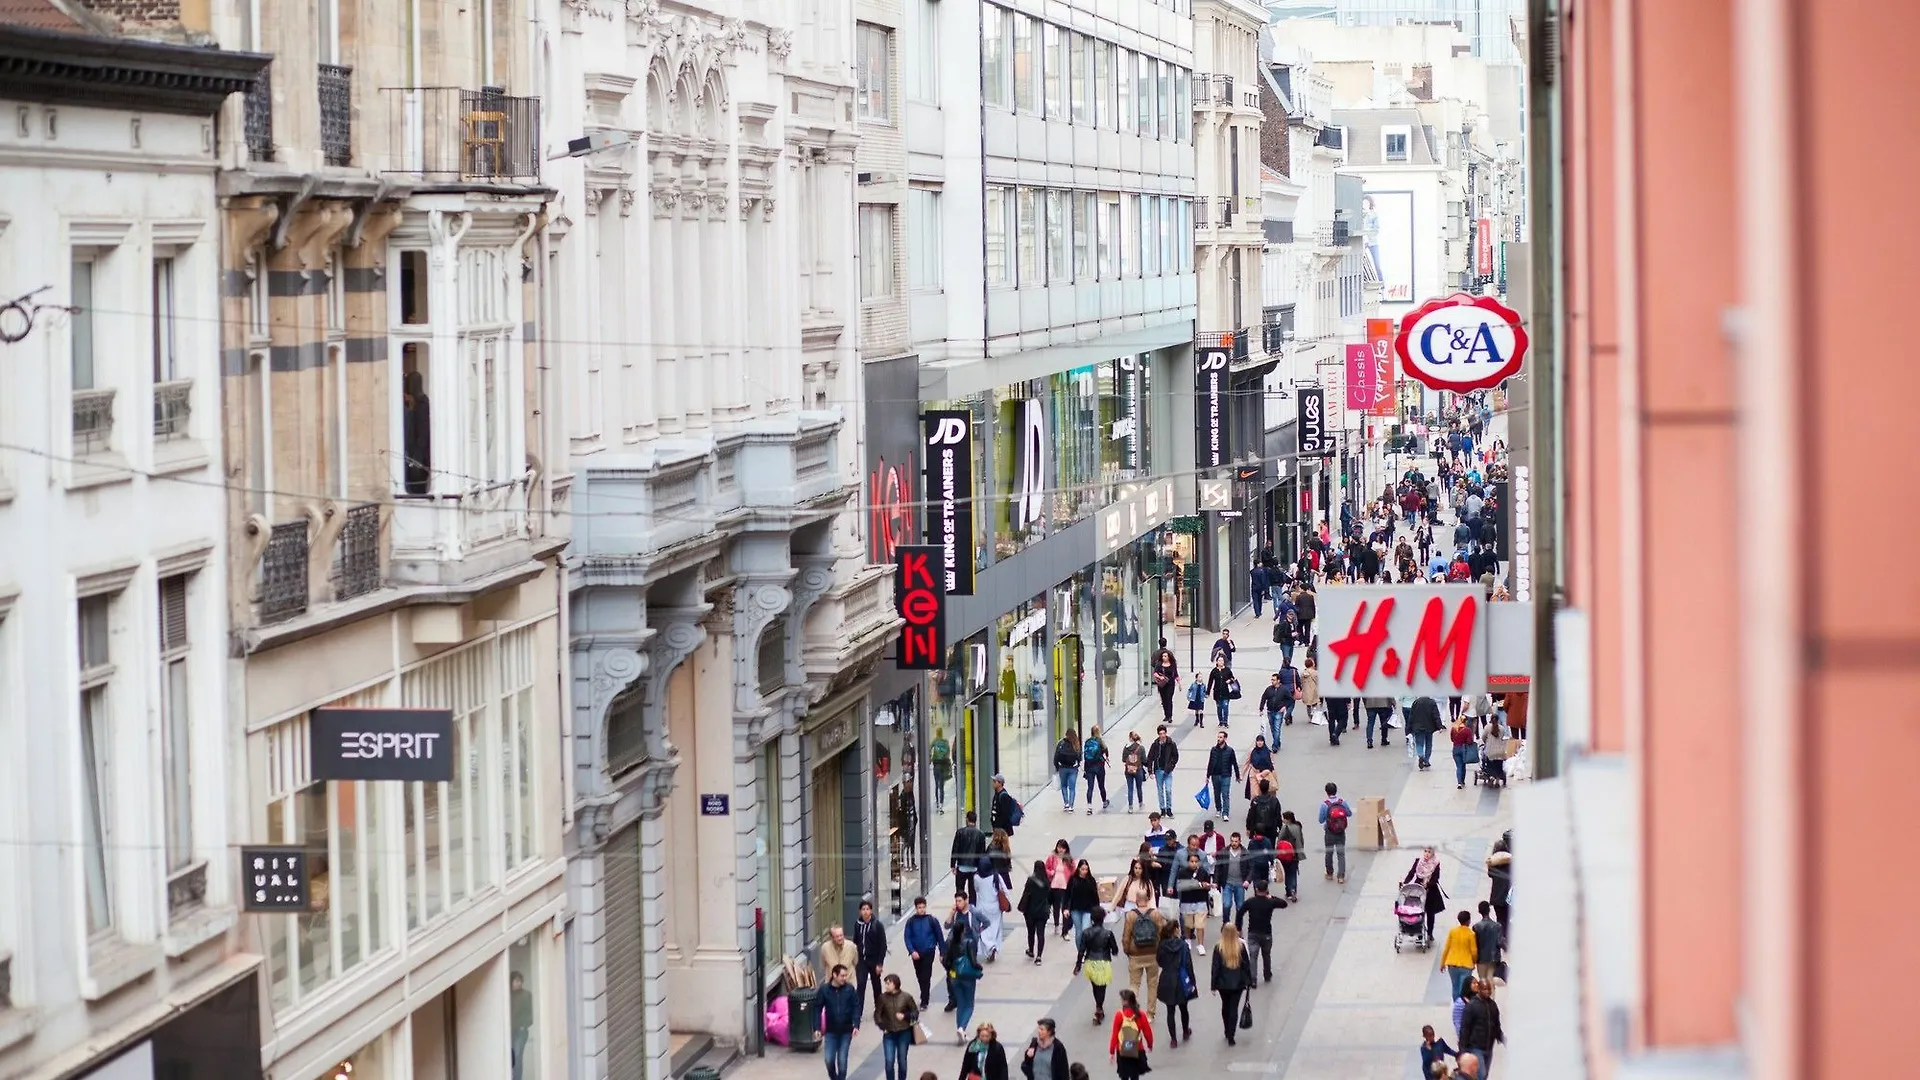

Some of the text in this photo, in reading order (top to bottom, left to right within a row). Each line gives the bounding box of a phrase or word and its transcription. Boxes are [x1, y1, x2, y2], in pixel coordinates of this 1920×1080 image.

[1202, 352, 1226, 371] JD
[1420, 322, 1504, 365] C&A
[1210, 372, 1219, 418] TRAINERS
[1353, 350, 1366, 403] Cassis
[929, 418, 966, 445] JD
[1211, 428, 1219, 451] KING
[942, 448, 955, 518] TRAINERS
[943, 532, 956, 568] KING
[1328, 596, 1477, 691] H&M
[341, 732, 440, 759] ESPRIT
